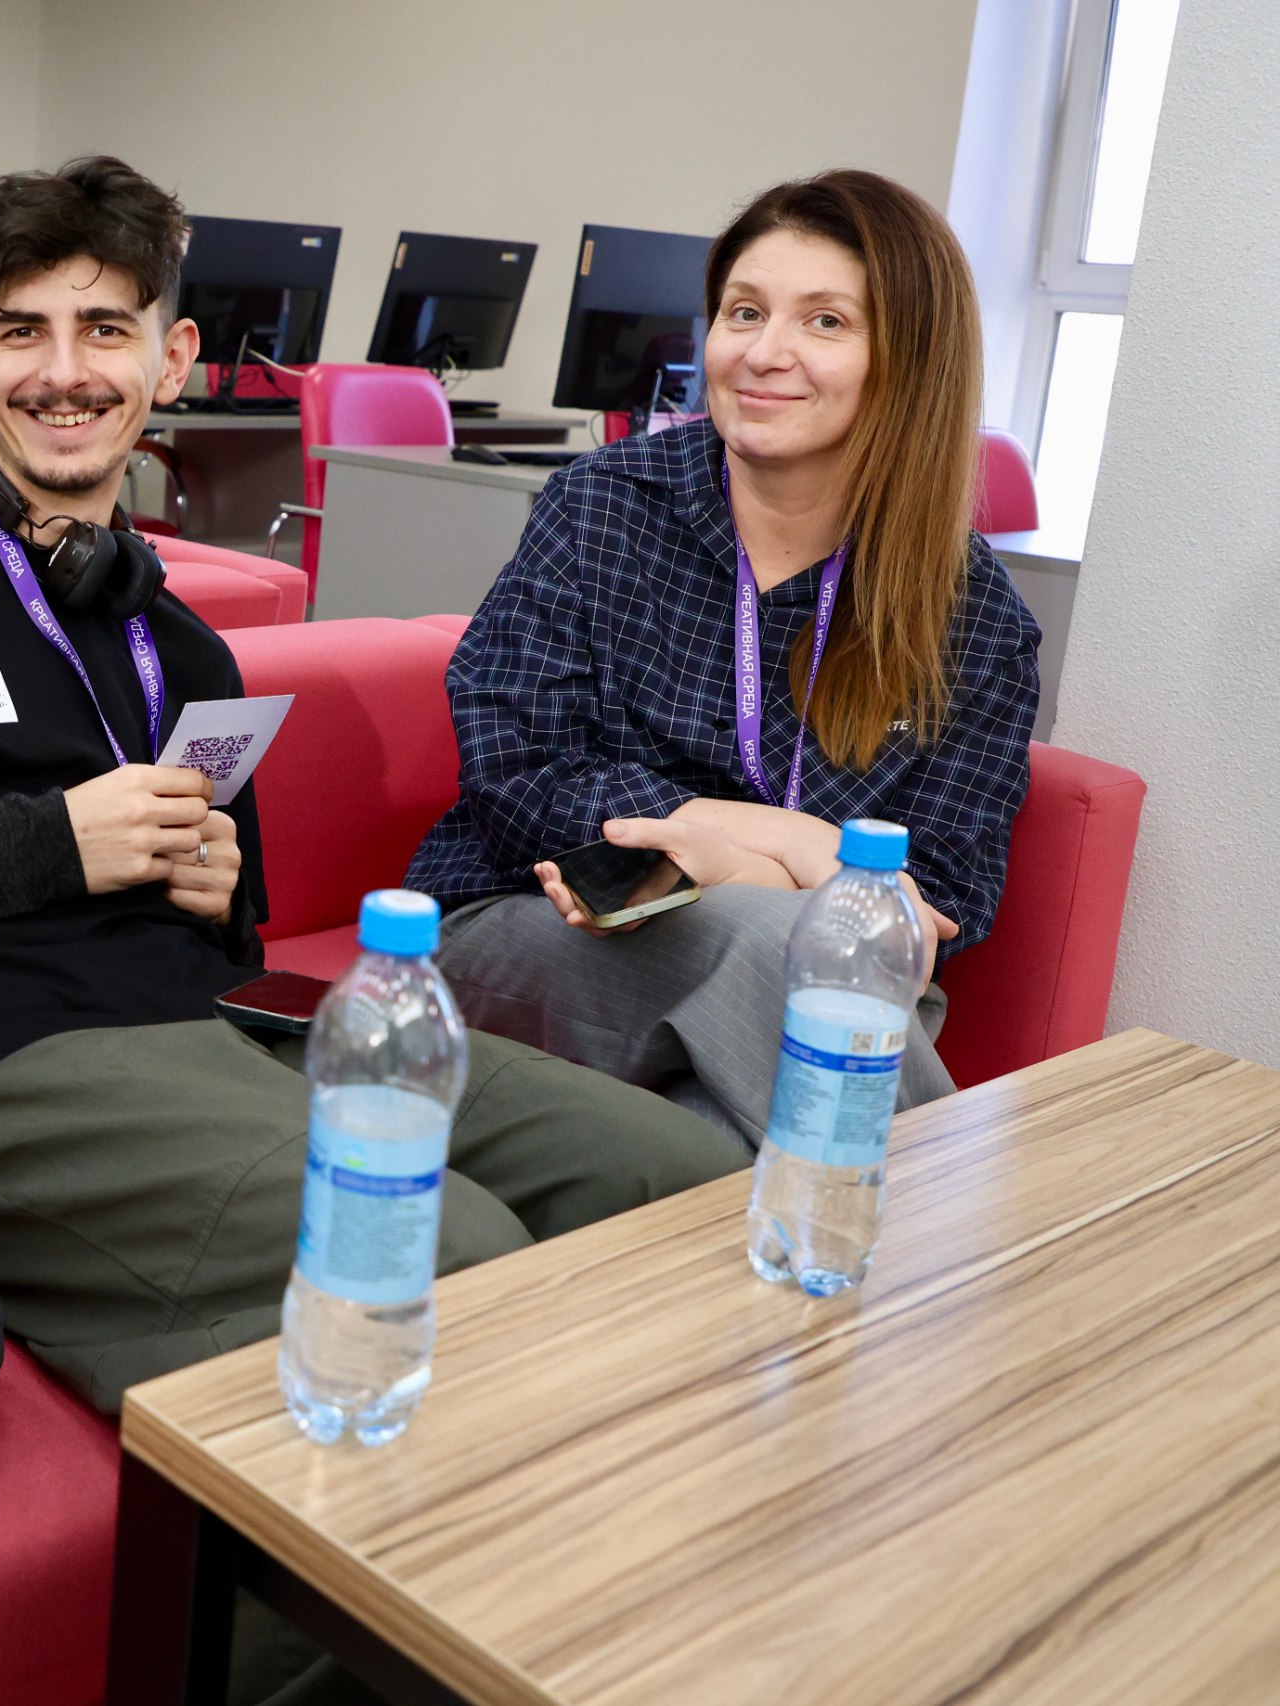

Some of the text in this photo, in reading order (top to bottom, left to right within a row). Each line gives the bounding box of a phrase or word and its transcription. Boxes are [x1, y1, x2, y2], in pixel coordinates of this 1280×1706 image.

[2, 541, 24, 578] СРЕДА
[29, 598, 85, 676] КРЕАТИВНАЯ
[819, 580, 835, 626] СРЕДА
[129, 614, 160, 734] КРЕАТИВНАЯ СРЕДА
[741, 584, 755, 719] КРЕАТИВНАЯ СРЕДА
